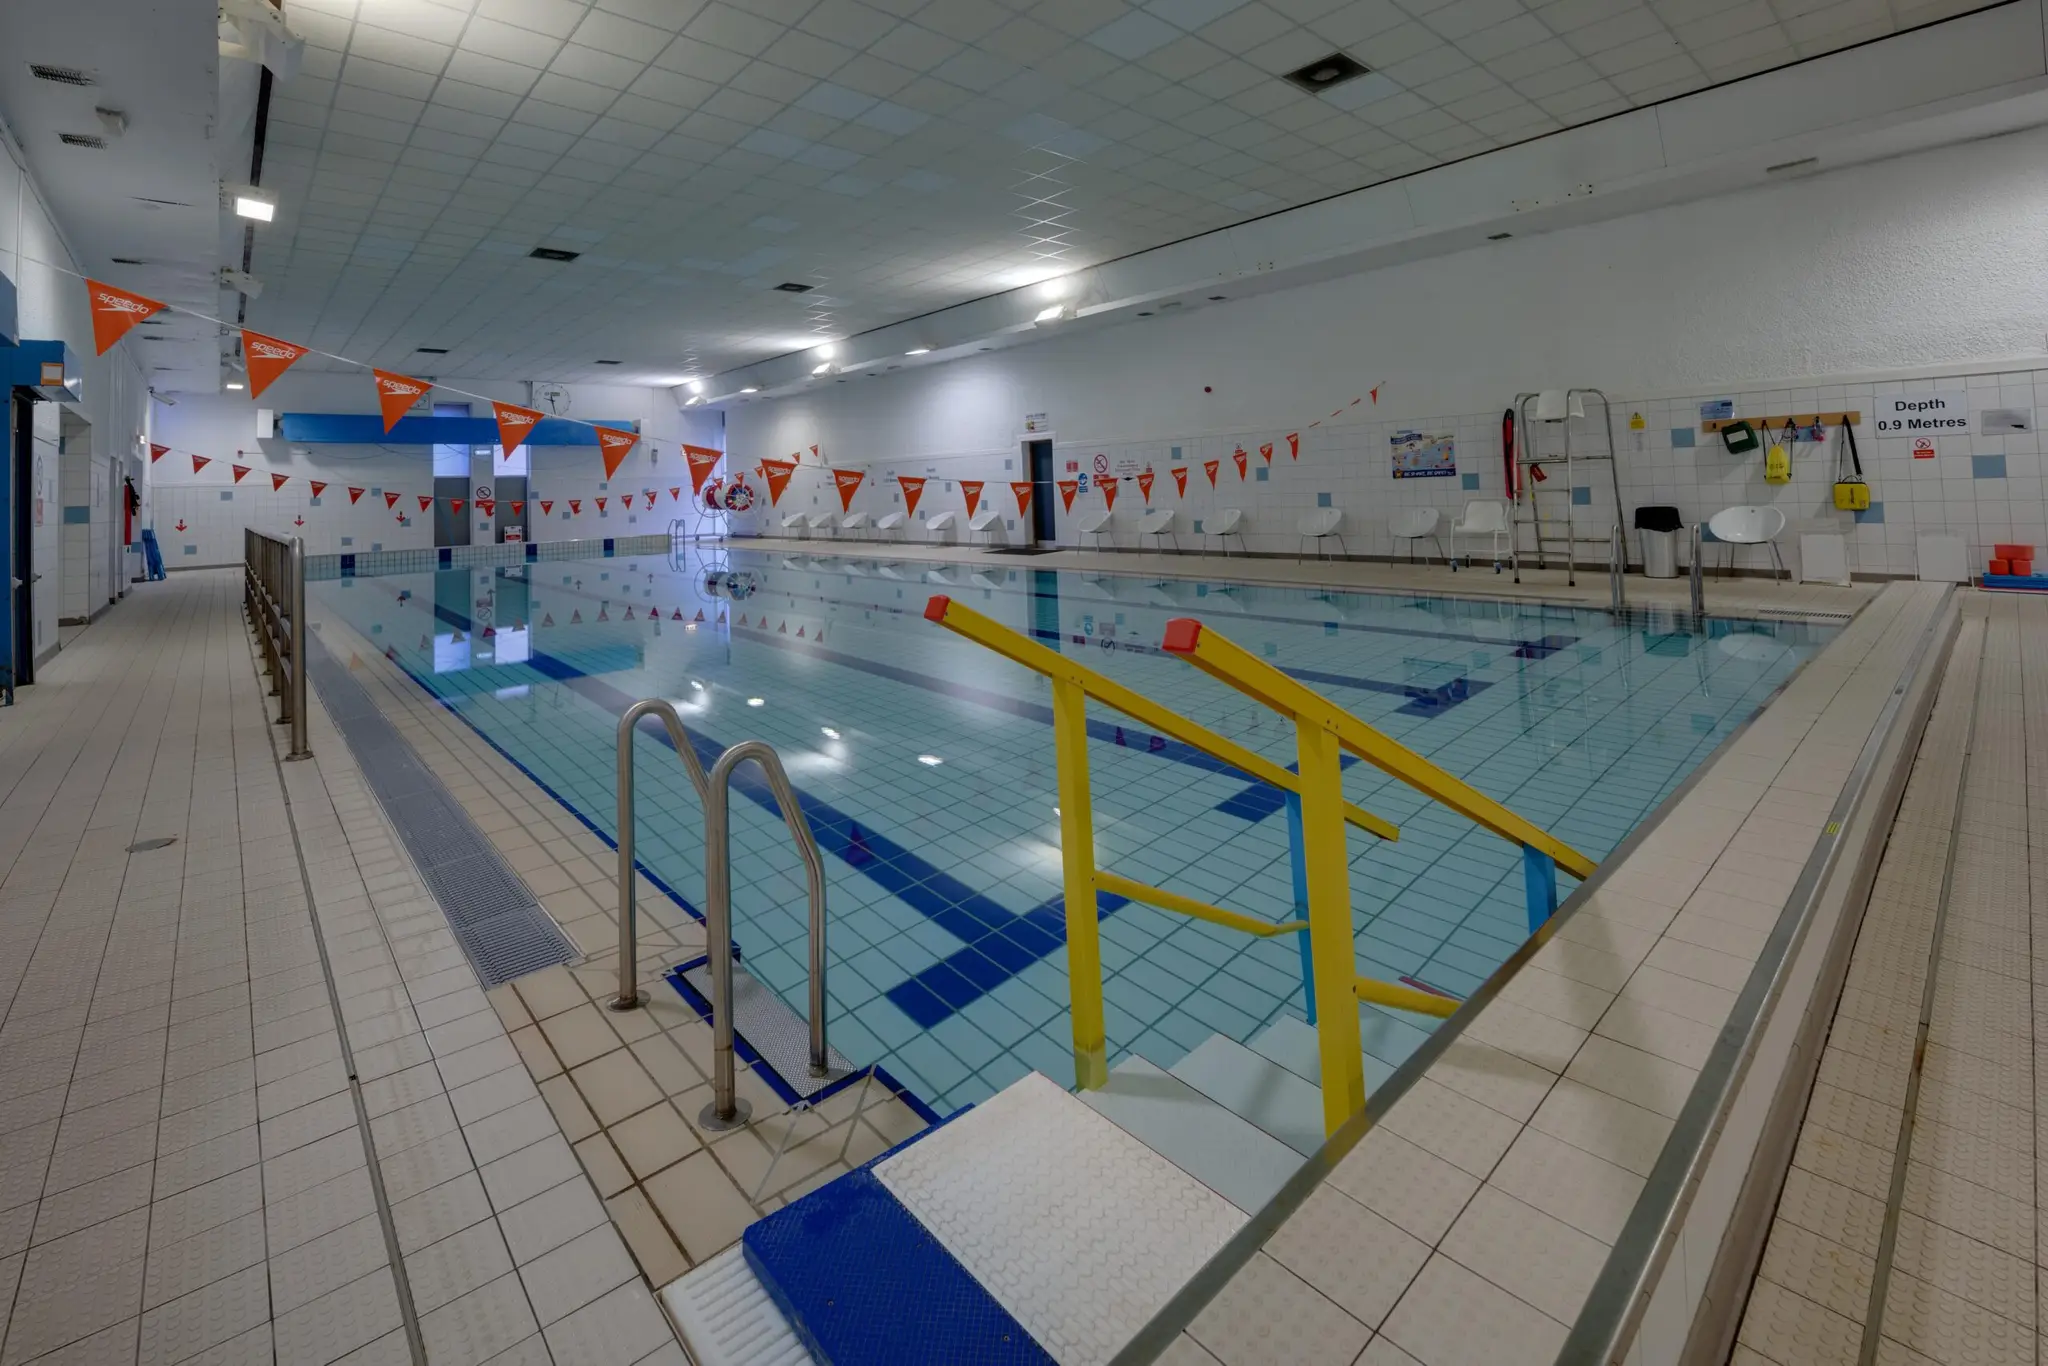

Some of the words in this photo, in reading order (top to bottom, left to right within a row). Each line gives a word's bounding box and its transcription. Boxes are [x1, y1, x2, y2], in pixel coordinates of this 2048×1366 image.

[97, 292, 150, 315] speedo
[251, 340, 297, 360] speedo
[383, 379, 422, 396] speedo
[1895, 399, 1946, 412] Depth
[501, 410, 535, 425] speedo
[1878, 419, 1902, 431] 0.9
[1908, 418, 1967, 430] Metres
[602, 433, 632, 446] speedo
